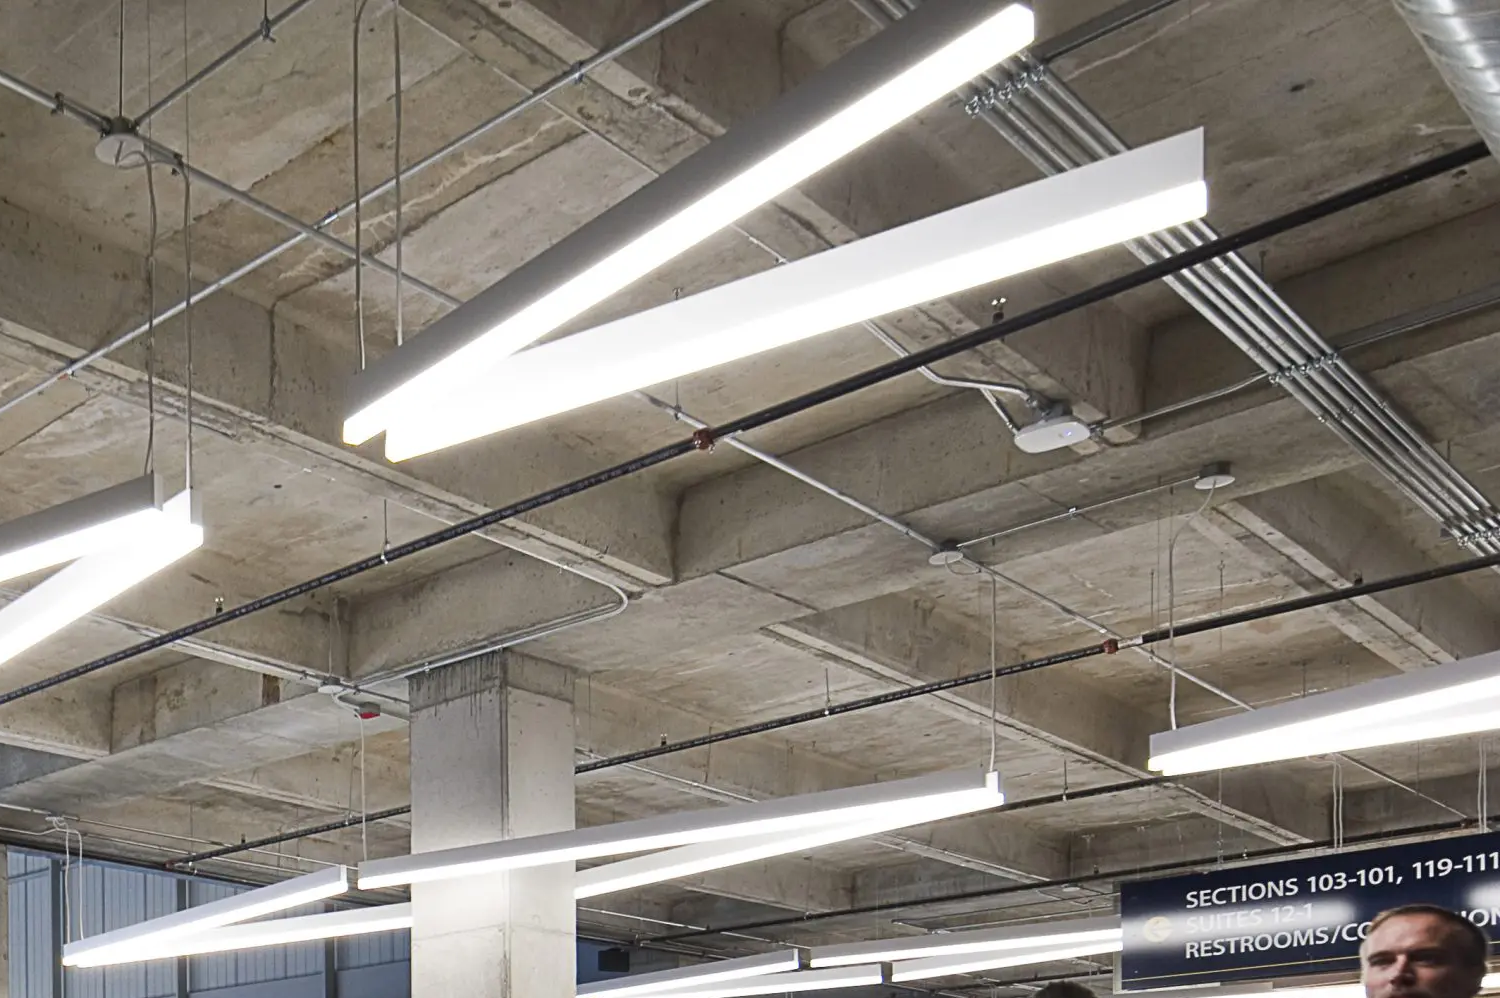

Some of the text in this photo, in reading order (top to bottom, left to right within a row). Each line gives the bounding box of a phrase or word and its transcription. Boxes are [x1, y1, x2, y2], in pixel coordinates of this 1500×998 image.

[1185, 851, 1499, 909] SECTIONS 103-101, 119-111
[1186, 902, 1313, 935] SUITES 12-1
